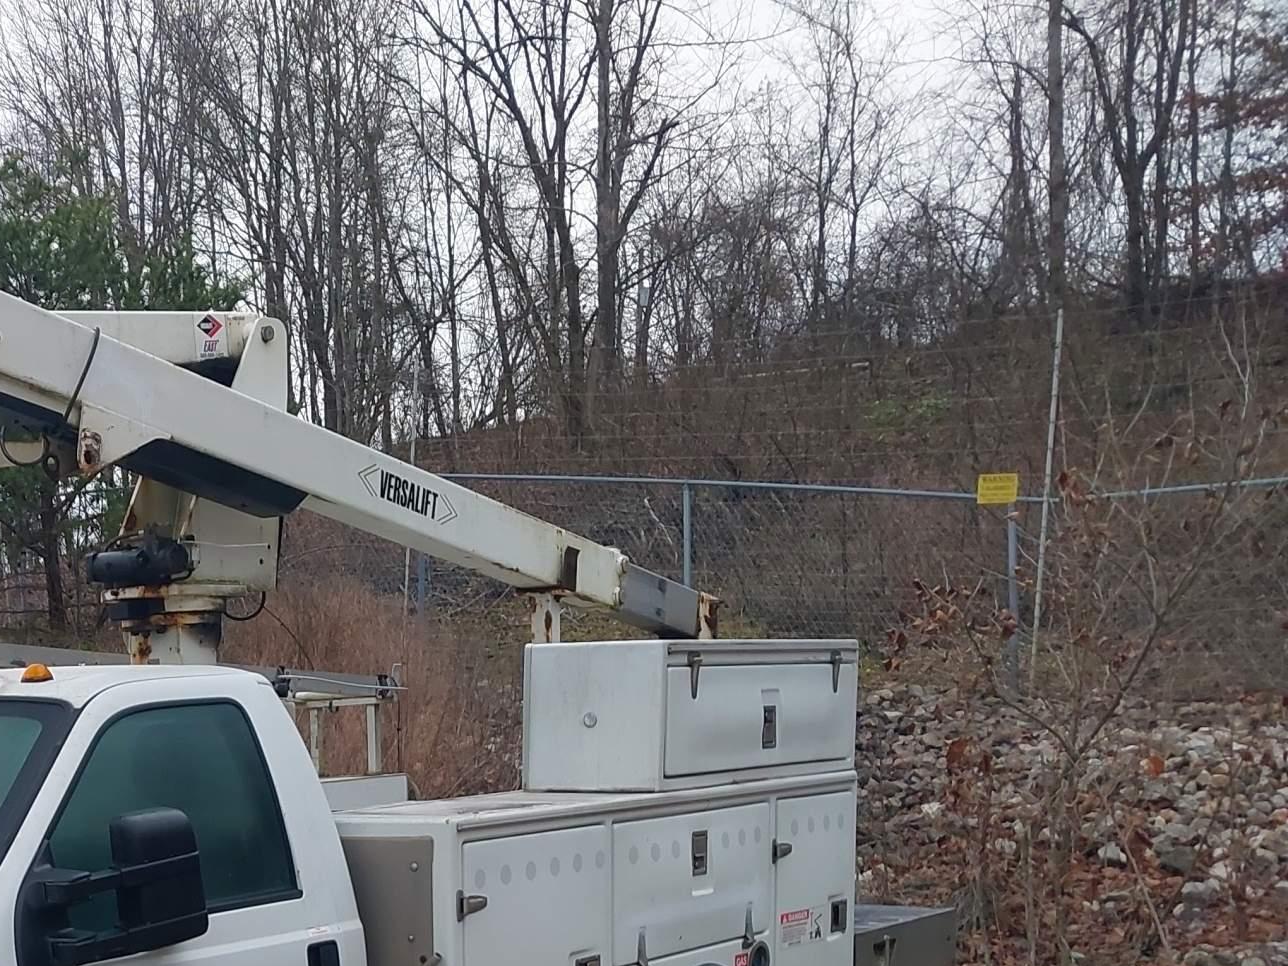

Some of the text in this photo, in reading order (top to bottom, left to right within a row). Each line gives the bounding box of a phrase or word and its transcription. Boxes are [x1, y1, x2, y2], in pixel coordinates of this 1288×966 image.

[203, 339, 218, 352] EAST
[380, 469, 439, 519] VERSALIFT
[787, 910, 809, 921] DANGER
[736, 955, 747, 966] GAS
